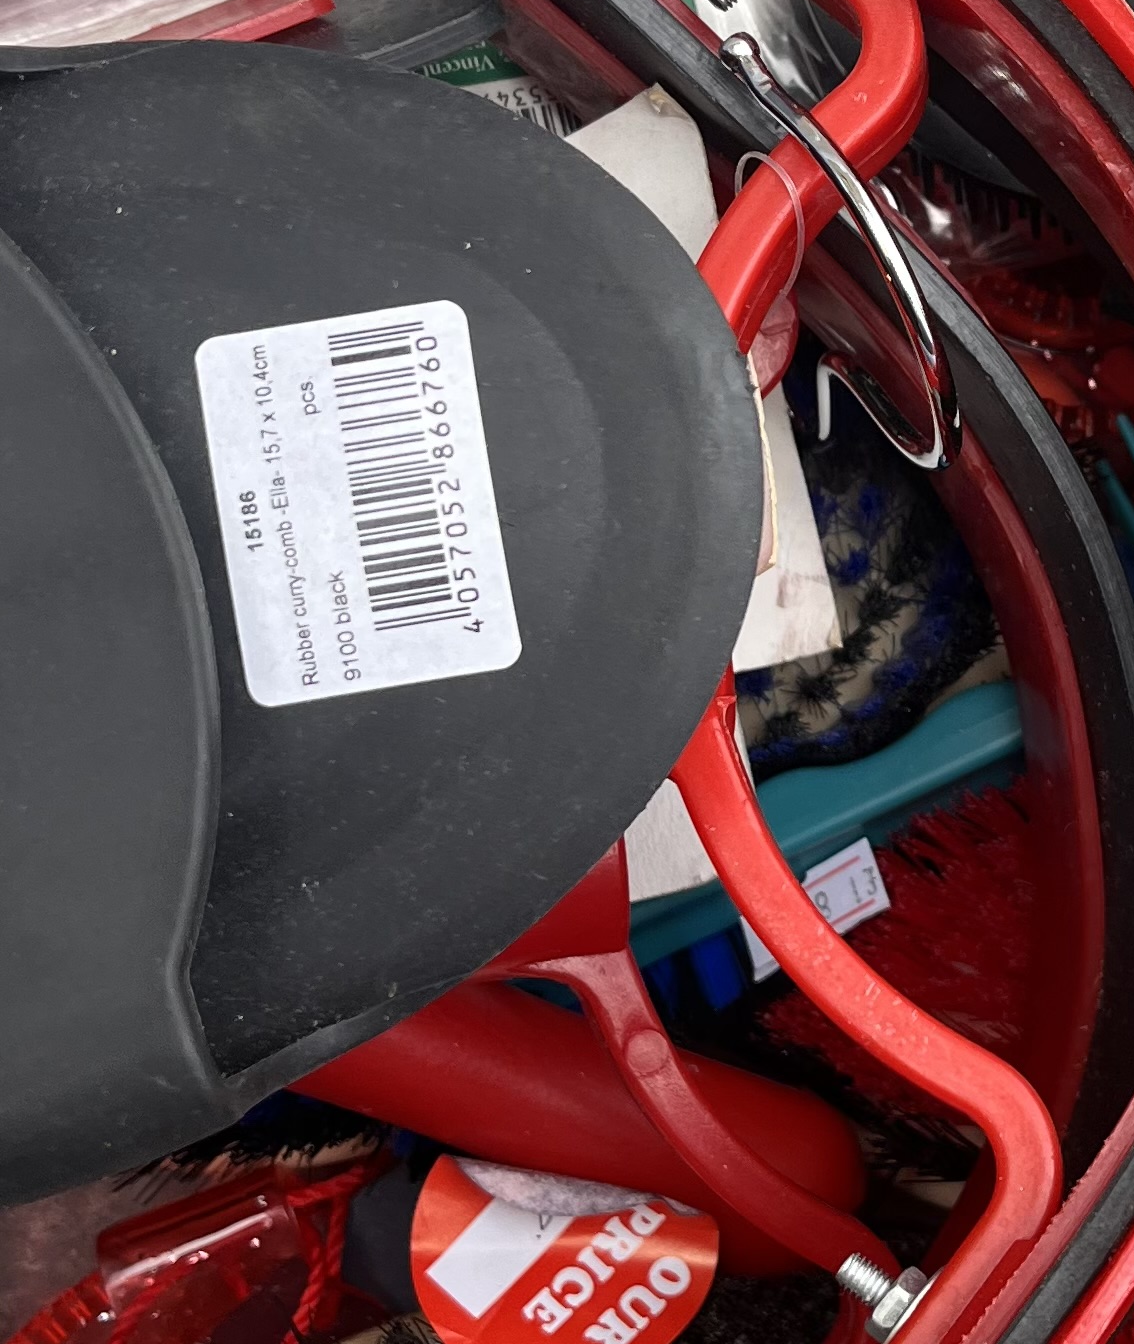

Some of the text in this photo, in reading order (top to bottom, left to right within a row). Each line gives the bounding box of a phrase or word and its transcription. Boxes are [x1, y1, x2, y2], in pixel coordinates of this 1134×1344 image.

[252, 344, 275, 406] 10,4cm
[261, 426, 282, 463] 15,7
[263, 410, 276, 423] x
[415, 335, 485, 634] 4 057052 866760
[239, 489, 264, 552] 15186
[279, 519, 308, 617] curry-comb
[328, 570, 353, 629] black
[297, 619, 320, 686] Rubber
[338, 633, 361, 681] 9100
[522, 1204, 667, 1335] PRICE
